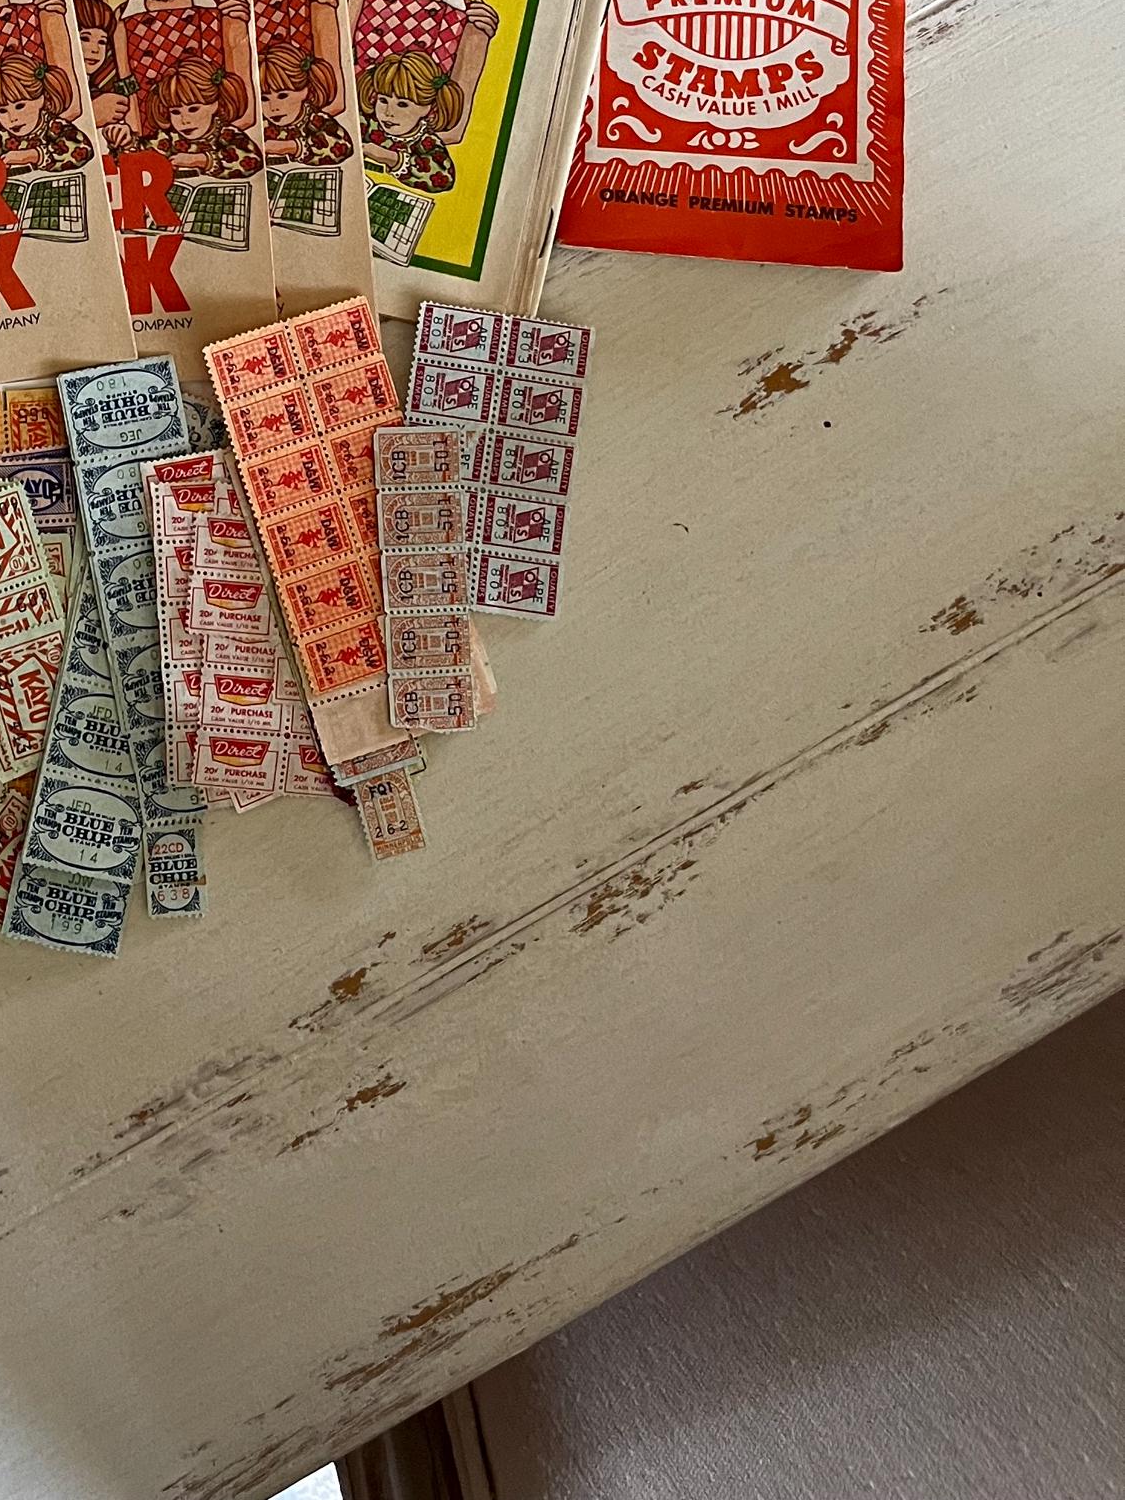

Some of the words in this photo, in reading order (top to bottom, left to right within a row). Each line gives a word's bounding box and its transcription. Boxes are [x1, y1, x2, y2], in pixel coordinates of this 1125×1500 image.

[632, 40, 825, 99] STAMPS
[641, 75, 691, 108] CASH
[696, 98, 757, 116] VALUE
[777, 86, 820, 111] MILL
[599, 187, 679, 208] ORANGE
[688, 194, 774, 215] PREMIUM
[784, 203, 858, 223] STAMPS
[419, 310, 433, 353] STAMPS
[488, 319, 502, 364] QUALITY
[506, 324, 519, 368] STAMPS
[577, 332, 590, 377] QUALITY
[101, 403, 150, 425] BLUE
[160, 463, 209, 483] Direct
[207, 584, 259, 603] Direct
[219, 611, 262, 623] PURCHASE
[214, 740, 262, 759] Direct
[224, 768, 267, 780] PURCHASE
[65, 812, 114, 832] BLUE
[375, 818, 409, 839] 262
[62, 825, 111, 847] CHIP
[149, 859, 198, 873] BLUE
[148, 870, 197, 885] CHIP
[46, 886, 97, 908] BLUE
[157, 887, 191, 901] 638
[44, 899, 96, 921] CHIP
